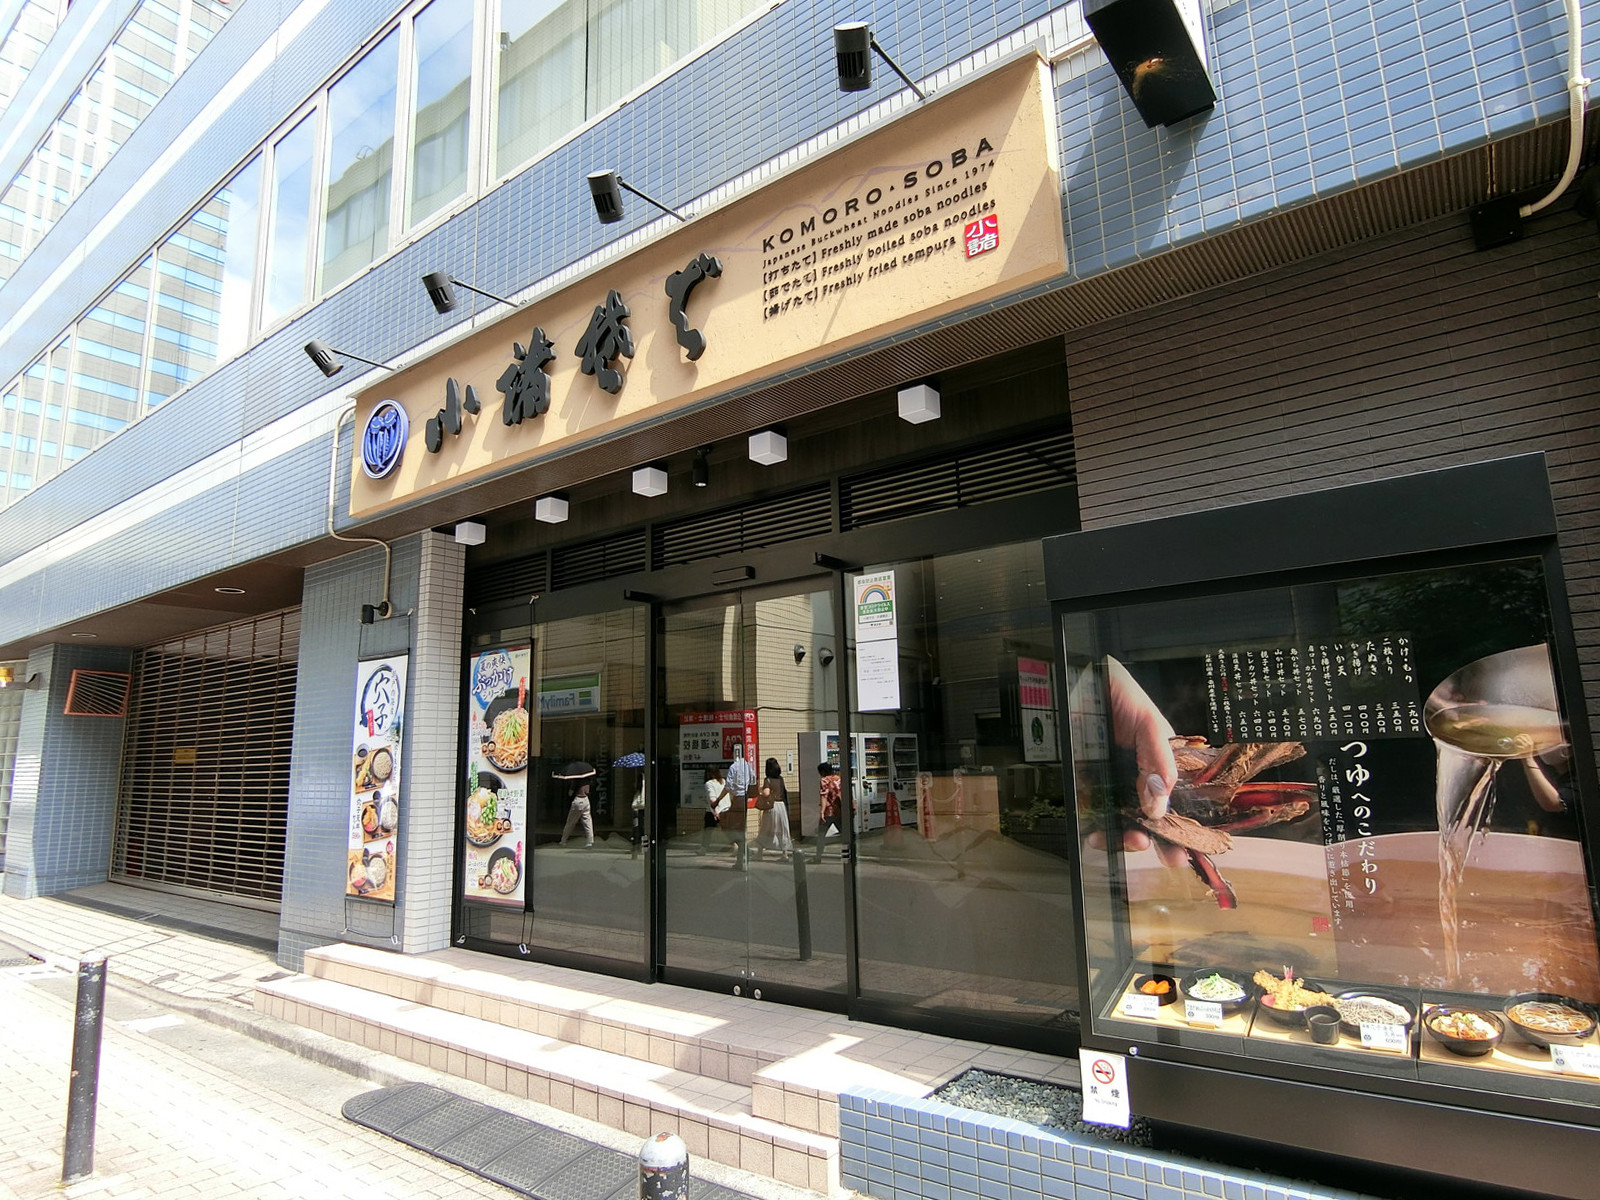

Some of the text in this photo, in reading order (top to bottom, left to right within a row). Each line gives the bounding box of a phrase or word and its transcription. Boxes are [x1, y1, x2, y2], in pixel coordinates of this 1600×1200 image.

[762, 137, 994, 253] KOMORO SOBA
[763, 159, 995, 270] Japanese Buckwheat Noodles Since 1974
[821, 235, 863, 260] Freshly
[867, 220, 898, 239] made
[903, 206, 932, 225] soba
[937, 181, 988, 210] noodles
[822, 252, 863, 277] Freshly
[868, 235, 905, 258] boiled
[910, 223, 939, 243] soba
[944, 198, 996, 229] noodles
[822, 271, 864, 296] Freshly
[868, 257, 897, 278] fried
[903, 236, 956, 264] tempura
[472, 666, 514, 695] ぶっかけ
[1334, 643, 1347, 676] いか天
[1350, 642, 1362, 676] かき揚げ
[1366, 640, 1378, 676] たぬき
[1382, 638, 1394, 675] 二枚もり
[1398, 638, 1413, 683] かけ・もり
[372, 673, 391, 730] 穴子
[483, 685, 506, 700] シリーズ
[1340, 741, 1377, 895] つゆへのこだわり
